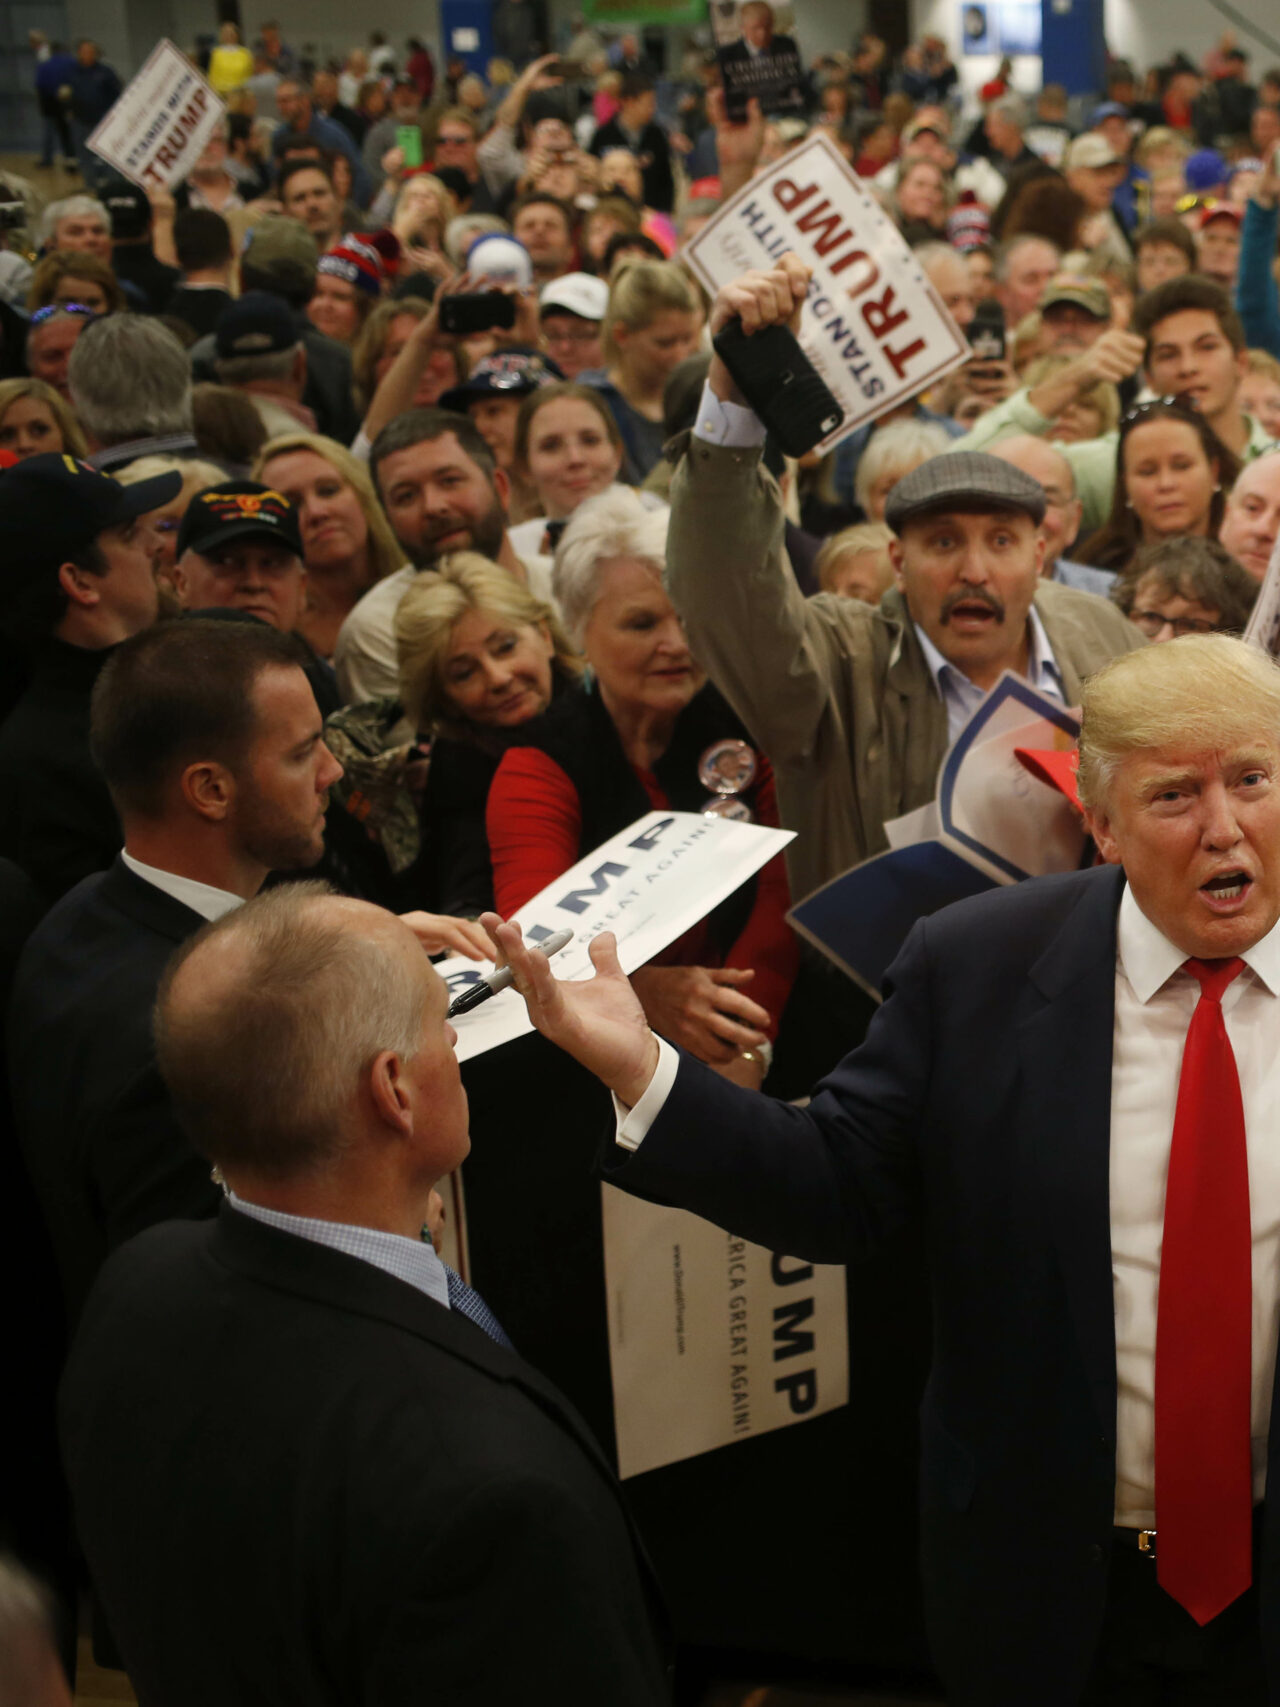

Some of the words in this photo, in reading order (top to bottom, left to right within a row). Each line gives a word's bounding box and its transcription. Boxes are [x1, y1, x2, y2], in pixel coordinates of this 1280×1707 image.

[142, 88, 208, 184] TRUMP
[772, 178, 928, 380] TRUMP
[728, 1294, 748, 1357] GREAT
